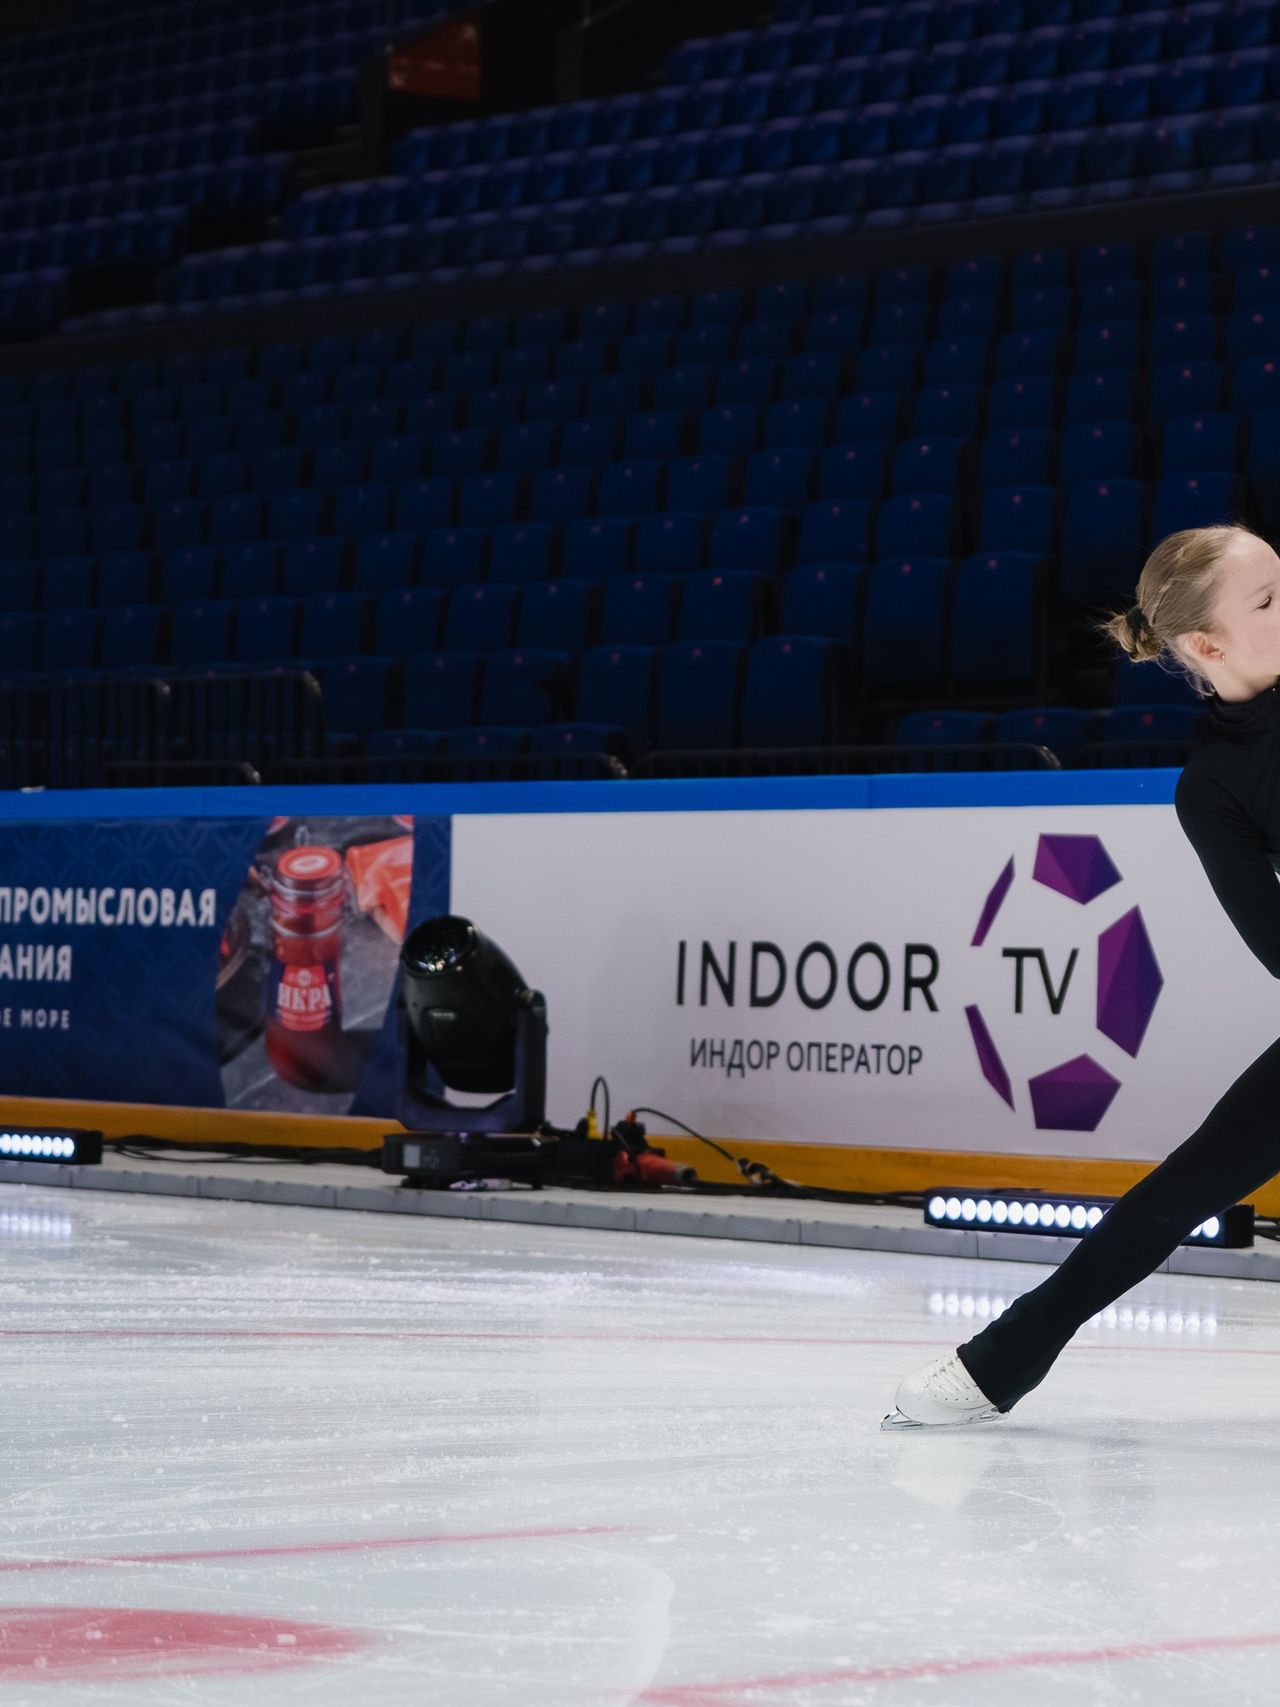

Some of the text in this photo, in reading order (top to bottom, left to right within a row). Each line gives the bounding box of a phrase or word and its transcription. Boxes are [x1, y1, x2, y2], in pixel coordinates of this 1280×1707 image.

[675, 940, 1080, 1015] INDOOR TV
[20, 1008, 70, 1030] МОРЕ
[689, 1037, 924, 1079] ИНДОР ОПЕРАТОР
